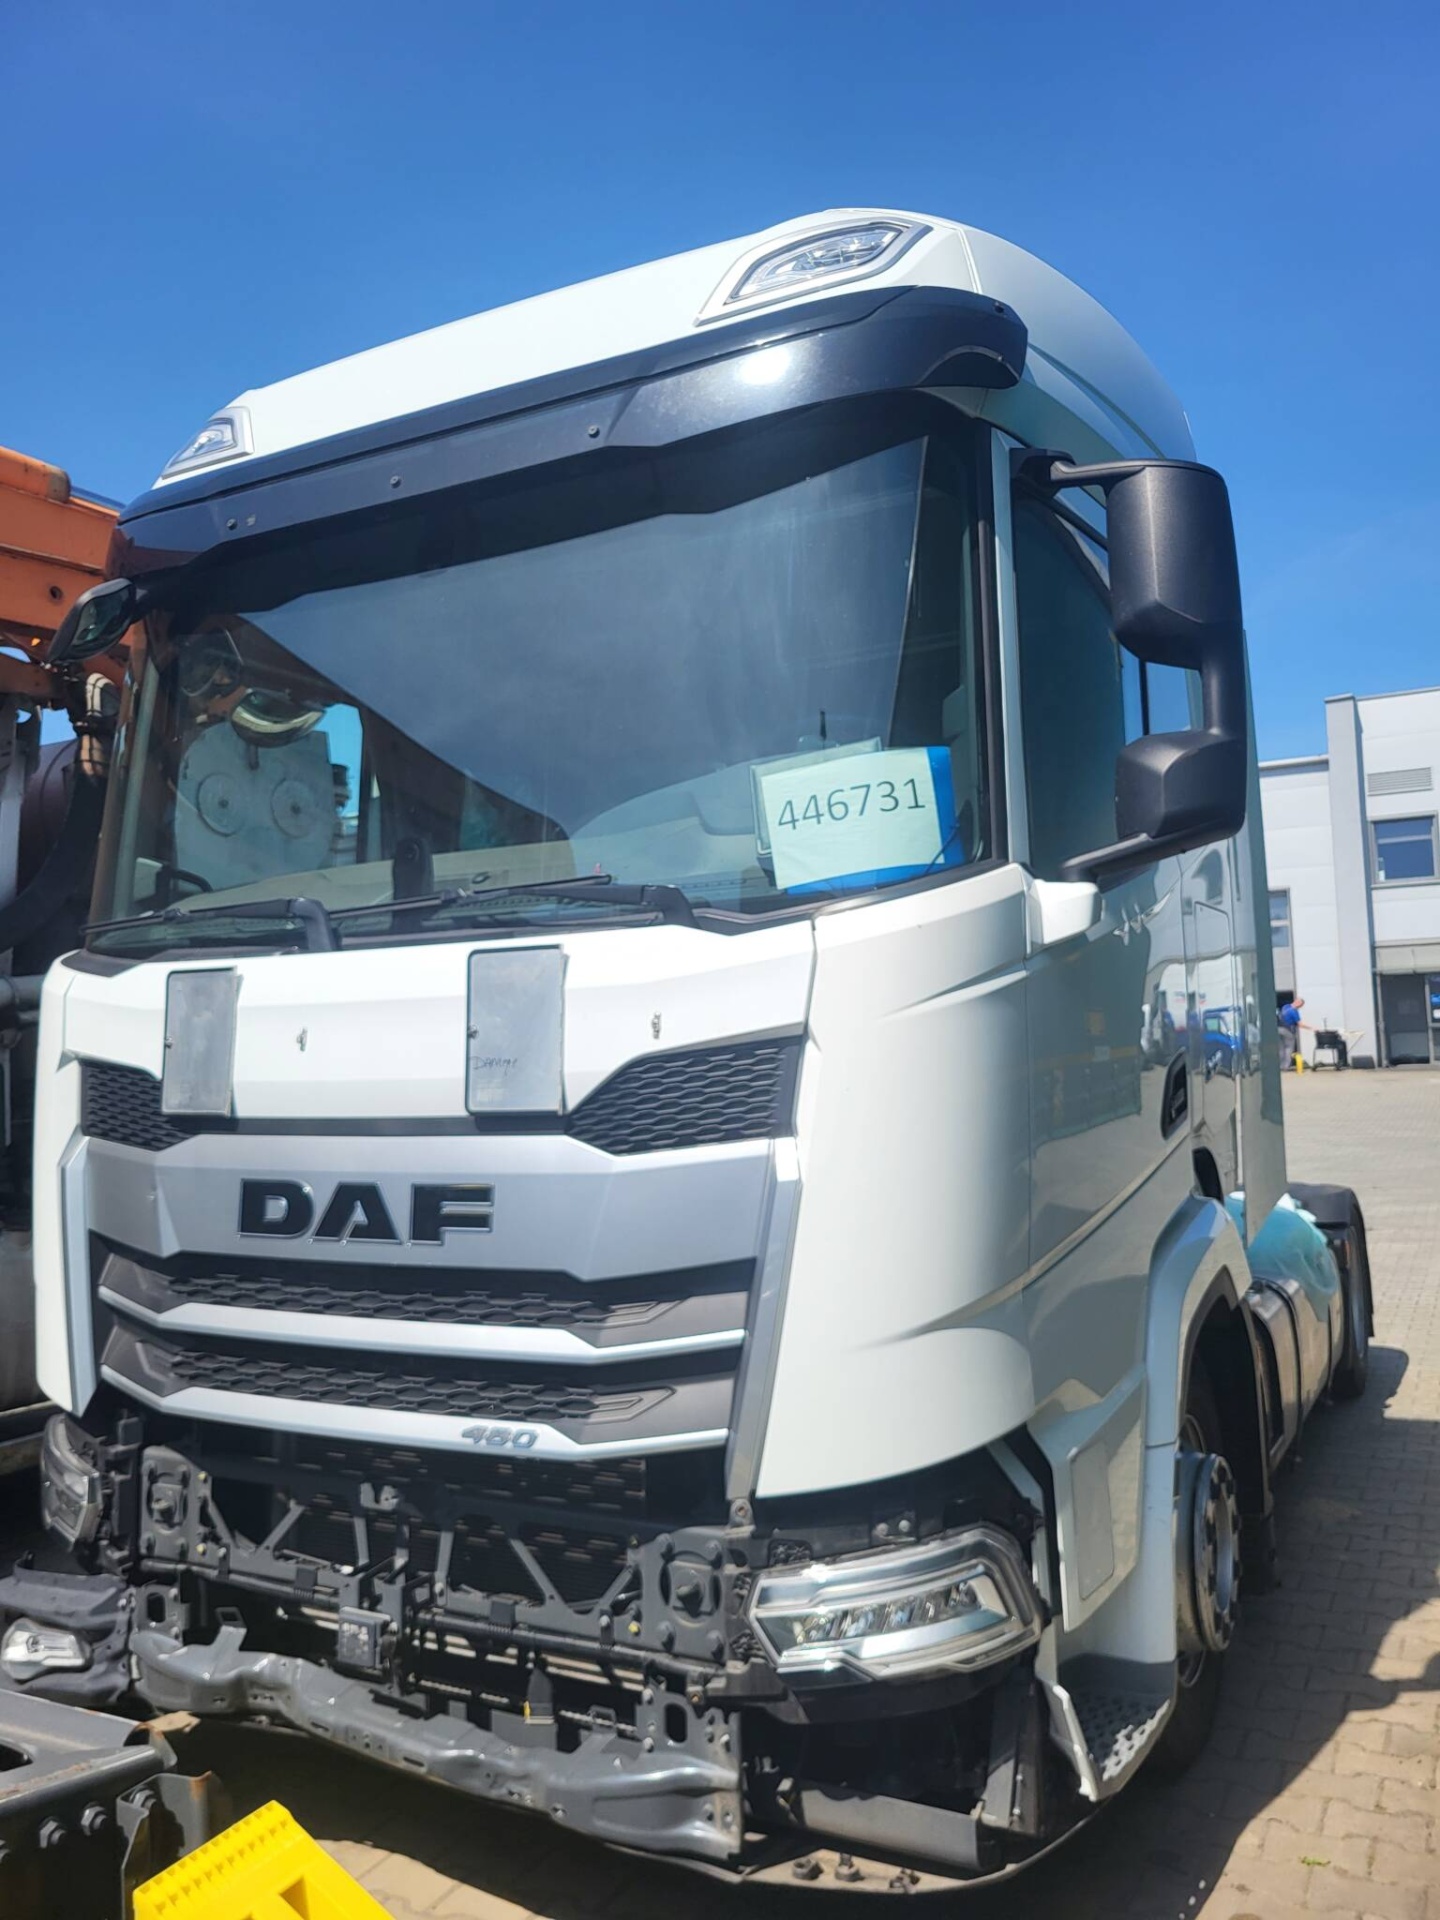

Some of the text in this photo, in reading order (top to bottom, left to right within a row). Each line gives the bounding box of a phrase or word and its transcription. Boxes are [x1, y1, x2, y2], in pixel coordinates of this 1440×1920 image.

[777, 778, 926, 830] 446731
[238, 1178, 495, 1247] DAF
[461, 1424, 539, 1448] 480
